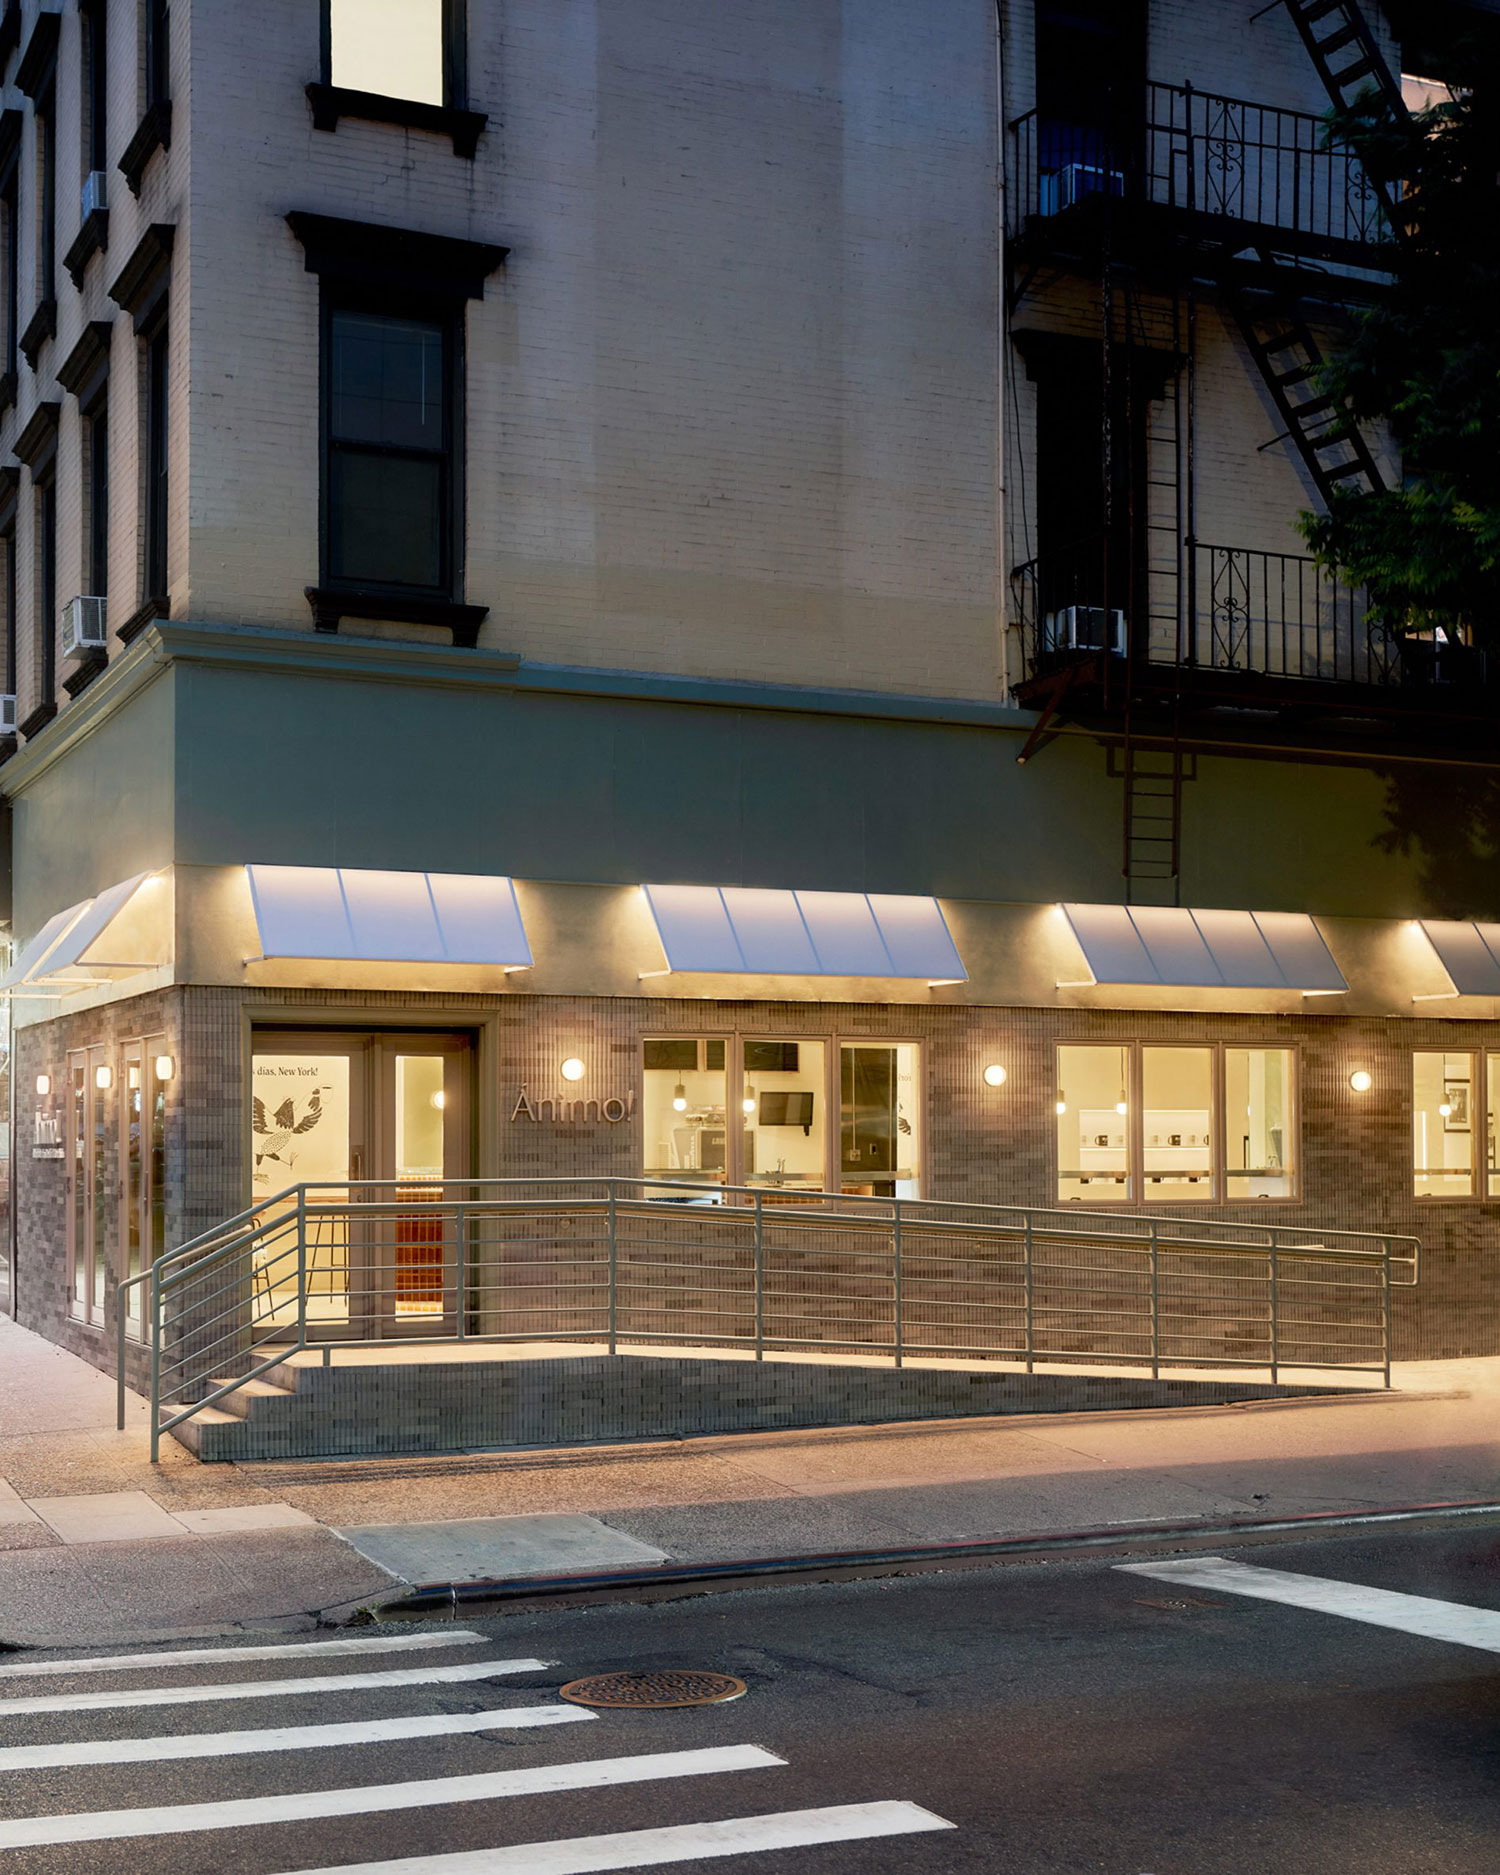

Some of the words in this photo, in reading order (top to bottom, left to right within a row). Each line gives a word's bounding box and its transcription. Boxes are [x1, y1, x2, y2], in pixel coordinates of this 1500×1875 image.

[278, 1066, 296, 1076] New
[297, 1066, 318, 1076] York!
[510, 1083, 634, 1122] Ánimo!
